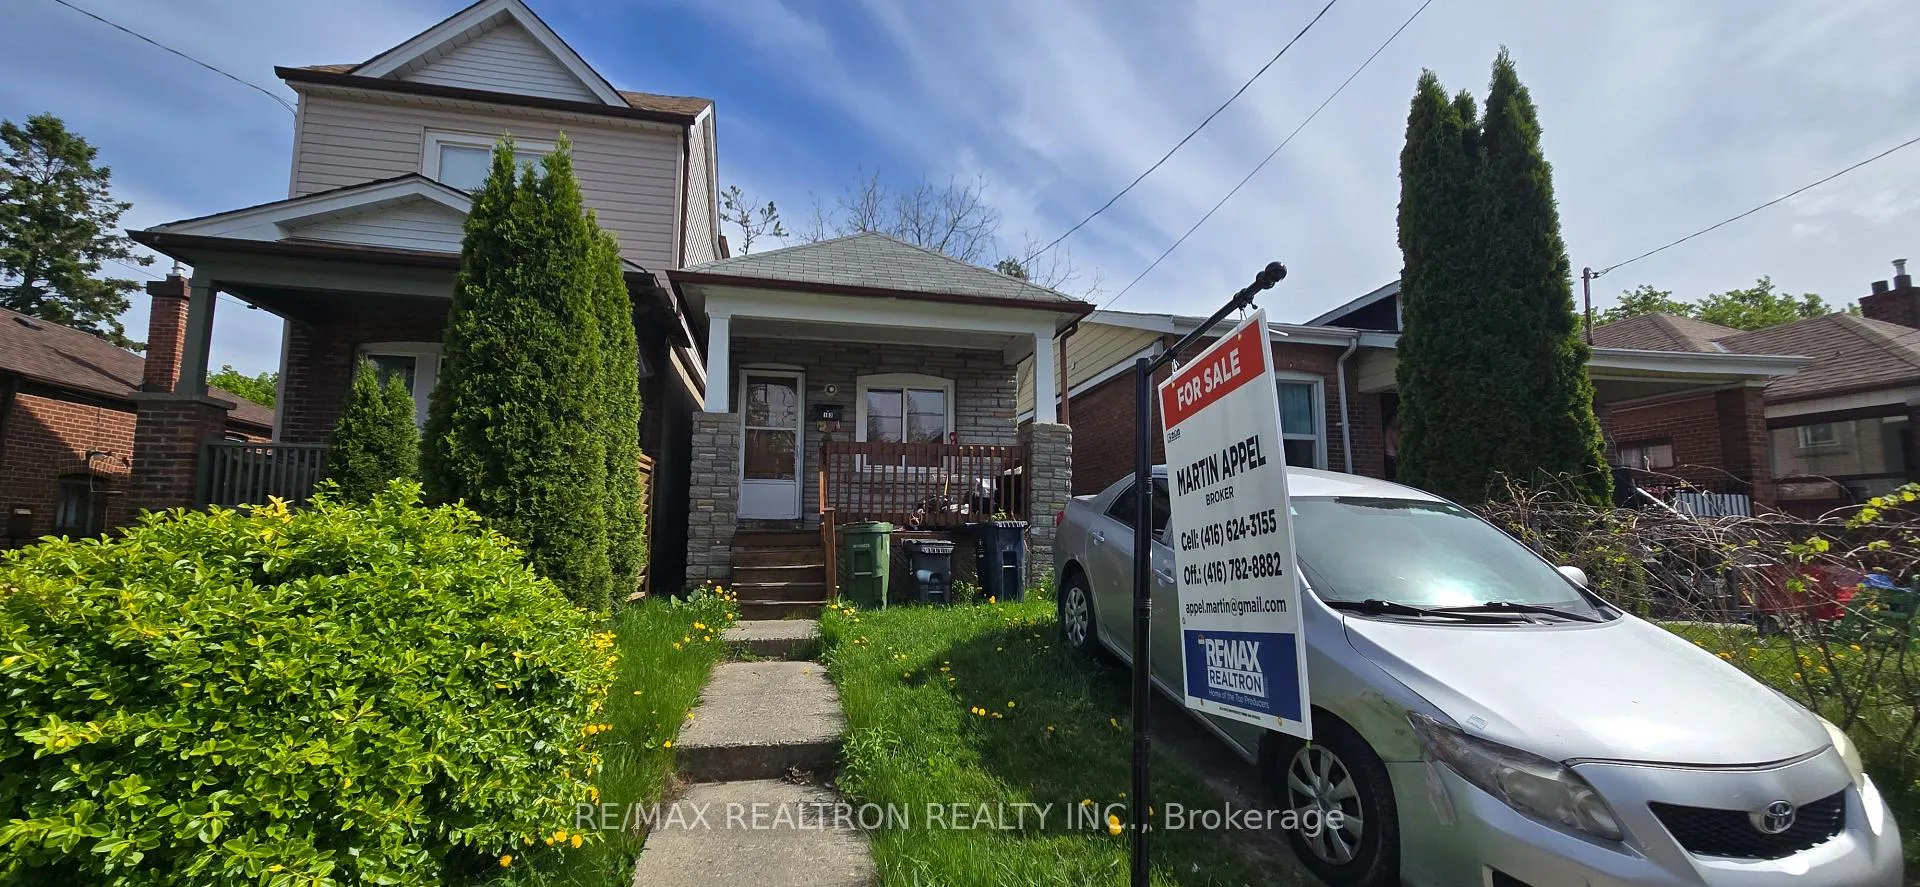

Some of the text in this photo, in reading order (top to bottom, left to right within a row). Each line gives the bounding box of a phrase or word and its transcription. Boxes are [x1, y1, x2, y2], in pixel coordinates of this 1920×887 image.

[1176, 347, 1241, 411] FOR SALE
[1176, 434, 1267, 497] MARTIN APPEL
[1205, 486, 1235, 506] BROKER
[1181, 508, 1277, 551] Cell: (416) 624-3155
[1184, 551, 1283, 587] Off.: (416) 782-8882
[1185, 596, 1287, 617] appel.martin@gmail.com
[1209, 669, 1262, 693] REALTRON
[1208, 688, 1221, 698] Home
[1244, 695, 1270, 709] Producers
